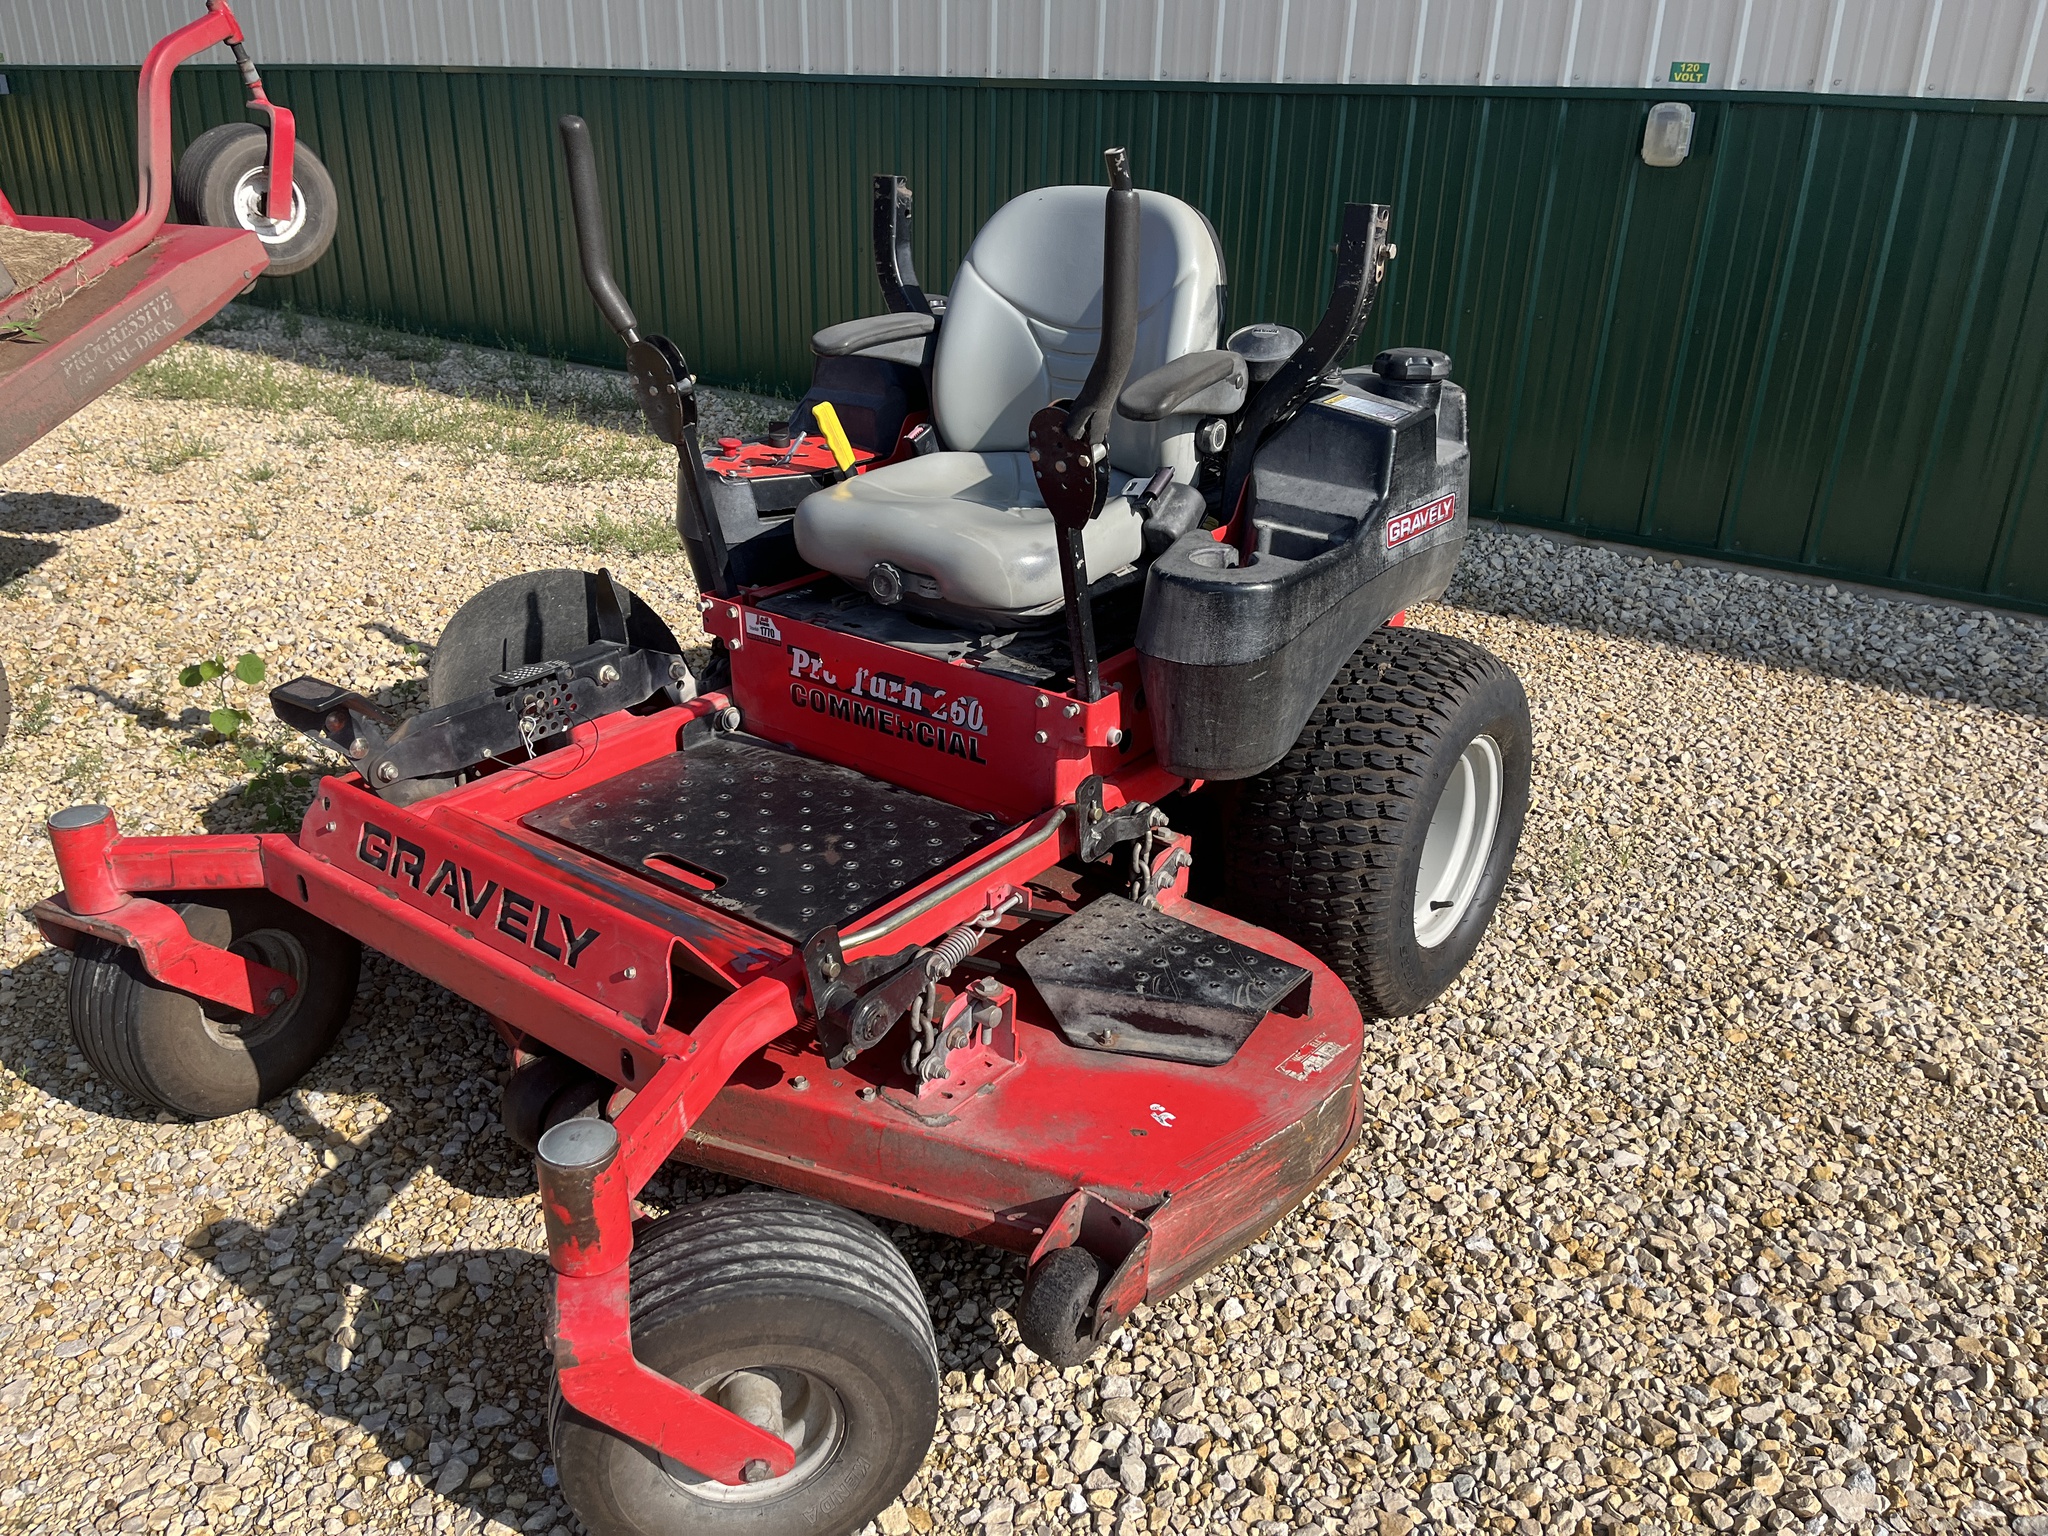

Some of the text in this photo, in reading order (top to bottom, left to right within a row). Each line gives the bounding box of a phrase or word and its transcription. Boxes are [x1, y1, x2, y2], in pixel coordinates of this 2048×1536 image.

[1674, 72, 1704, 83] VOLT
[1680, 63, 1700, 73] 120
[60, 291, 173, 379] PROGRESSIVE
[103, 315, 176, 372] TRI-DECK
[1389, 498, 1453, 542] GRAVELY
[789, 683, 987, 765] COMMERCIAL
[932, 690, 984, 731] 260
[356, 821, 601, 969] GRAVELY
[802, 1456, 871, 1525] KENDA
